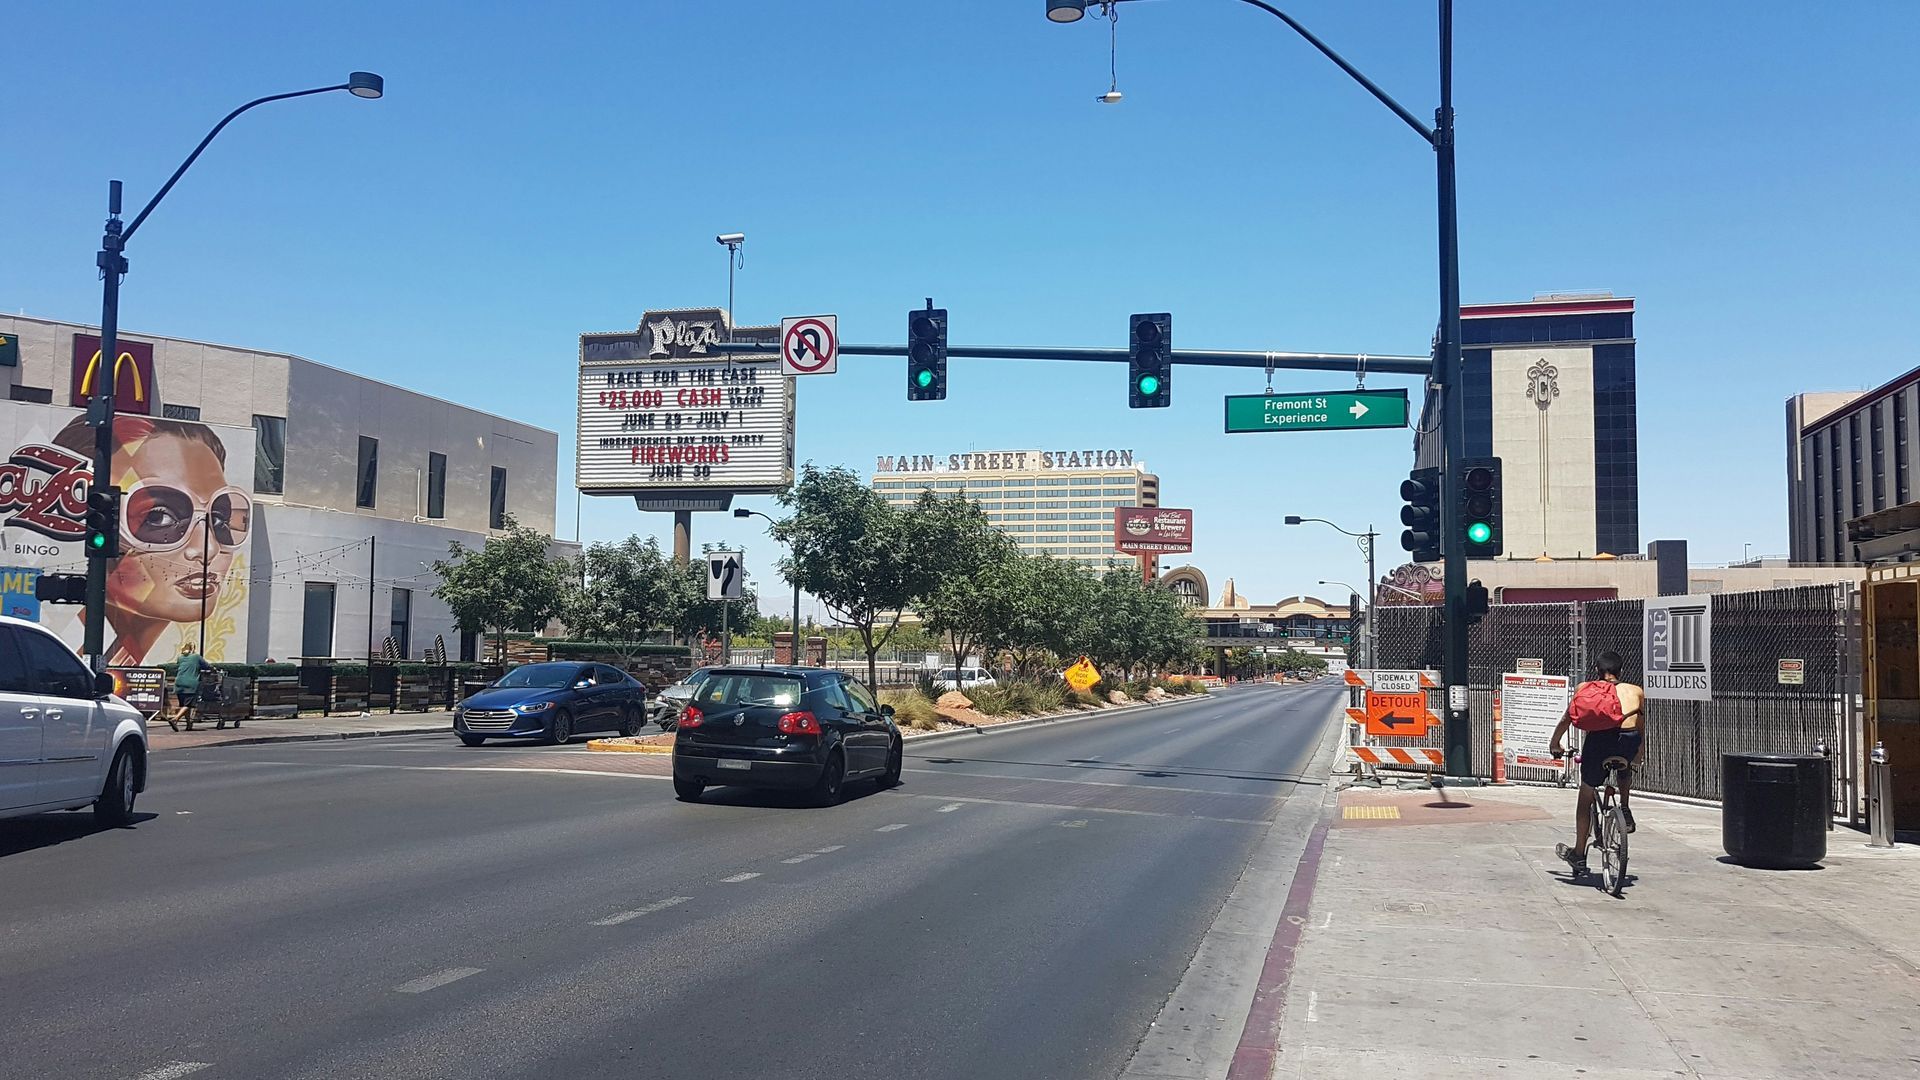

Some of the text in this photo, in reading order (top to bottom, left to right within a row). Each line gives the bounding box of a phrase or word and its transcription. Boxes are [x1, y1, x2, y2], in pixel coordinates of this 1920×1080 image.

[648, 316, 720, 355] Plaza
[608, 367, 756, 384] RACE FOR THE CASE
[599, 388, 722, 410] $25,000 CASH
[730, 396, 762, 405] GRABS
[1264, 398, 1327, 410] Fremont St
[622, 413, 655, 426] JUNE
[665, 413, 682, 425] 29
[697, 411, 729, 425] JULY
[1264, 412, 1328, 426] Experience
[600, 434, 764, 446] INDEPENDENCE DAY POOL PARTY
[632, 445, 730, 464] FIREWORKS
[877, 450, 1133, 472] MAIN STREET STATION
[649, 465, 711, 478] JUNE 30
[1161, 524, 1185, 532] Brewery
[15, 544, 59, 556] BINGO
[1649, 610, 1667, 669] TRÉ
[1648, 675, 1707, 689] BUILDERS
[1372, 697, 1420, 708] DETOUR
